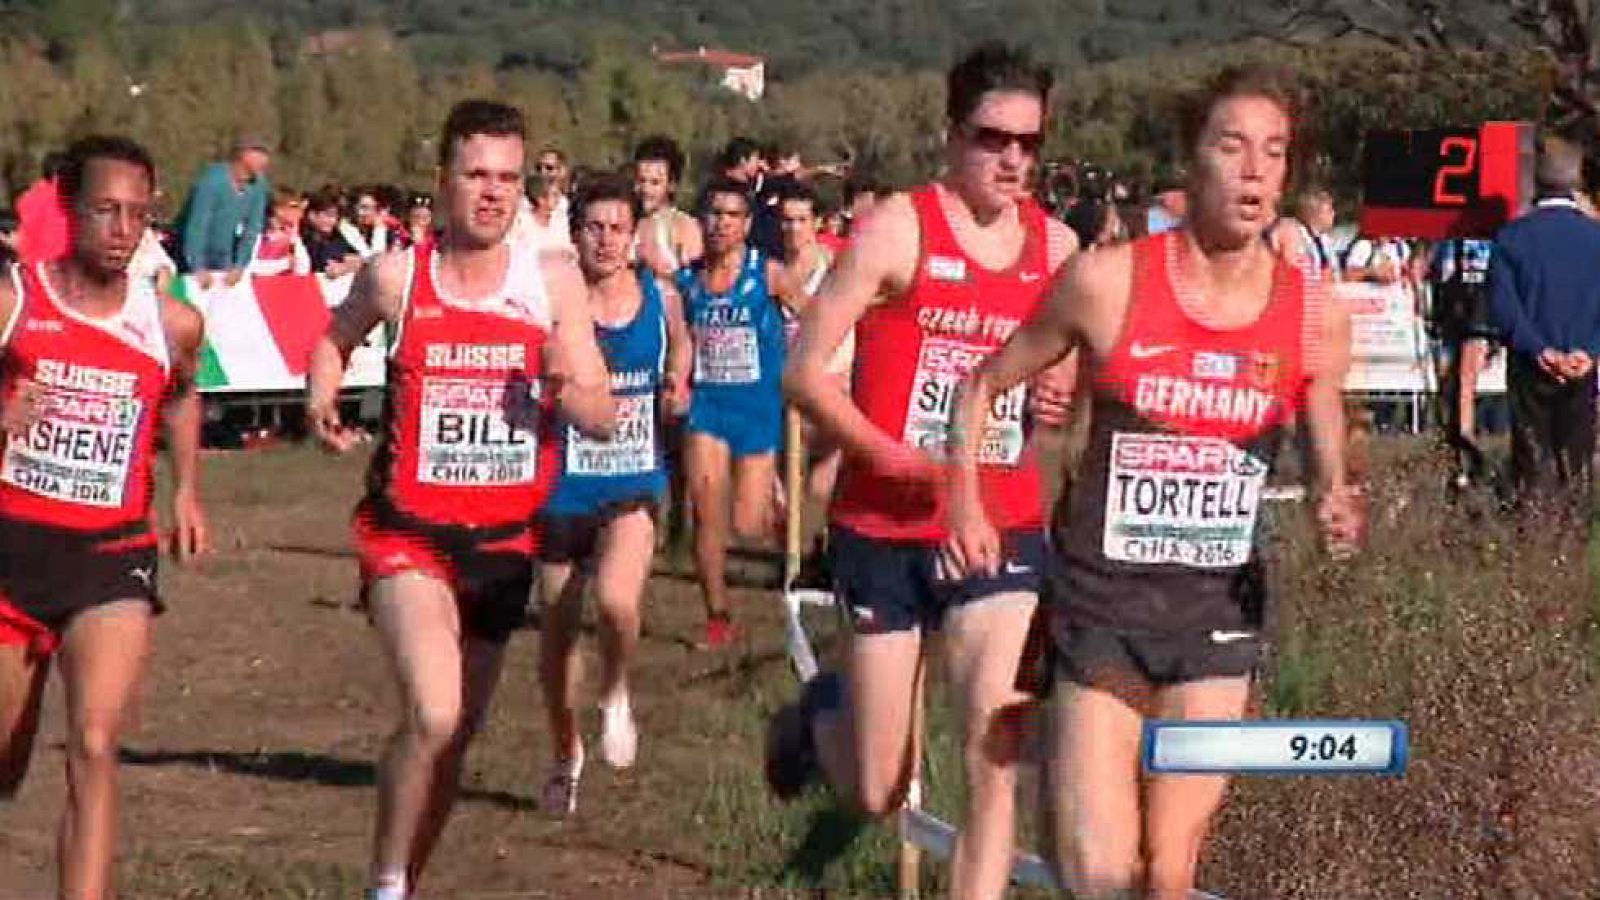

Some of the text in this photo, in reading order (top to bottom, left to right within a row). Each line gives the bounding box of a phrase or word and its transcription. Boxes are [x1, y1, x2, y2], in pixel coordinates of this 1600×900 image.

[1433, 137, 1476, 204] 2
[424, 343, 526, 370] SUISSE
[35, 358, 138, 395] SUISSE
[1136, 374, 1275, 425] GERMANY
[437, 412, 526, 445] BILL
[1116, 437, 1229, 473] SPAR
[13, 468, 60, 494] CHIA
[431, 465, 480, 482] CHIA
[1116, 475, 1250, 519] TORTELL
[1123, 539, 1182, 559] CHIA
